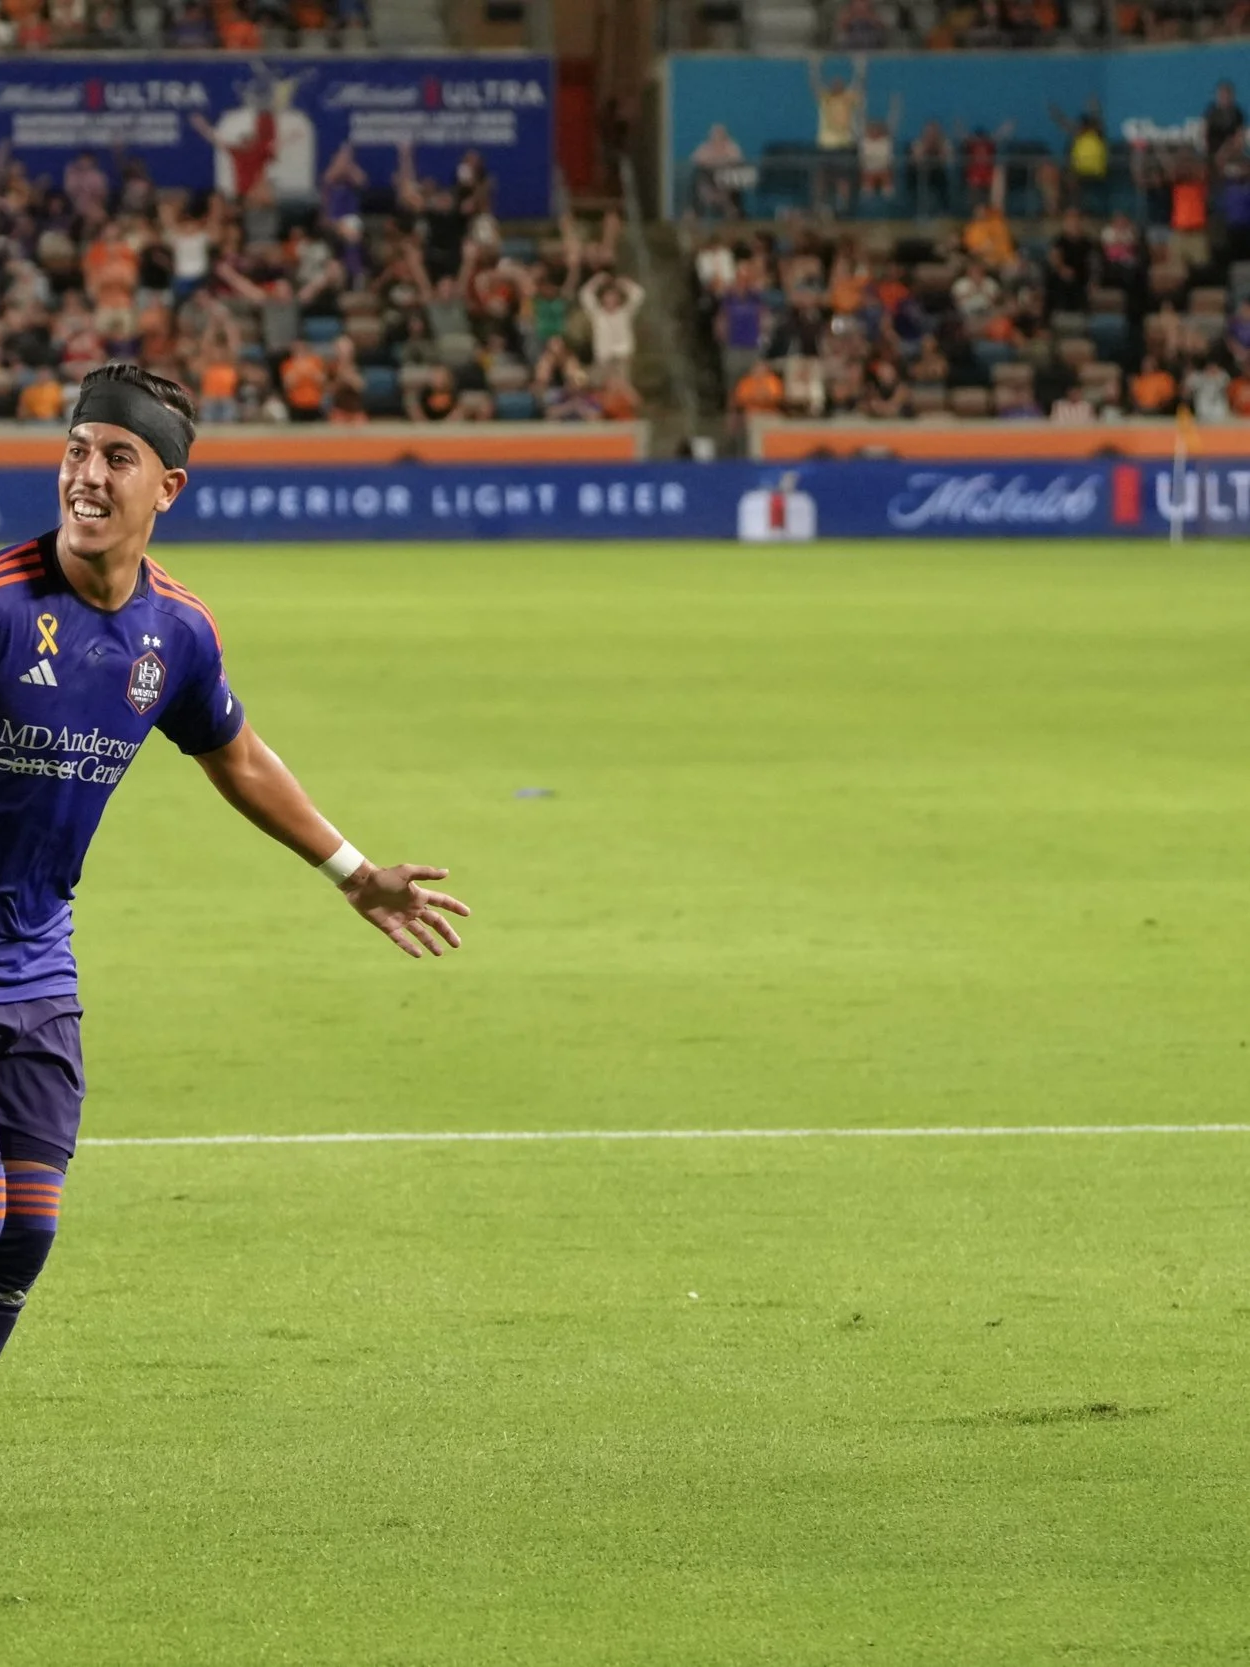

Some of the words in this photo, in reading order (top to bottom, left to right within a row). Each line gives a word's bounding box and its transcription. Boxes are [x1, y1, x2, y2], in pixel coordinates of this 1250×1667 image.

[104, 80, 209, 110] ULTRA
[442, 79, 545, 109] ULTRA
[196, 484, 410, 519] SUPERIOR
[431, 484, 555, 517] LIGHT
[578, 482, 686, 515] BEER
